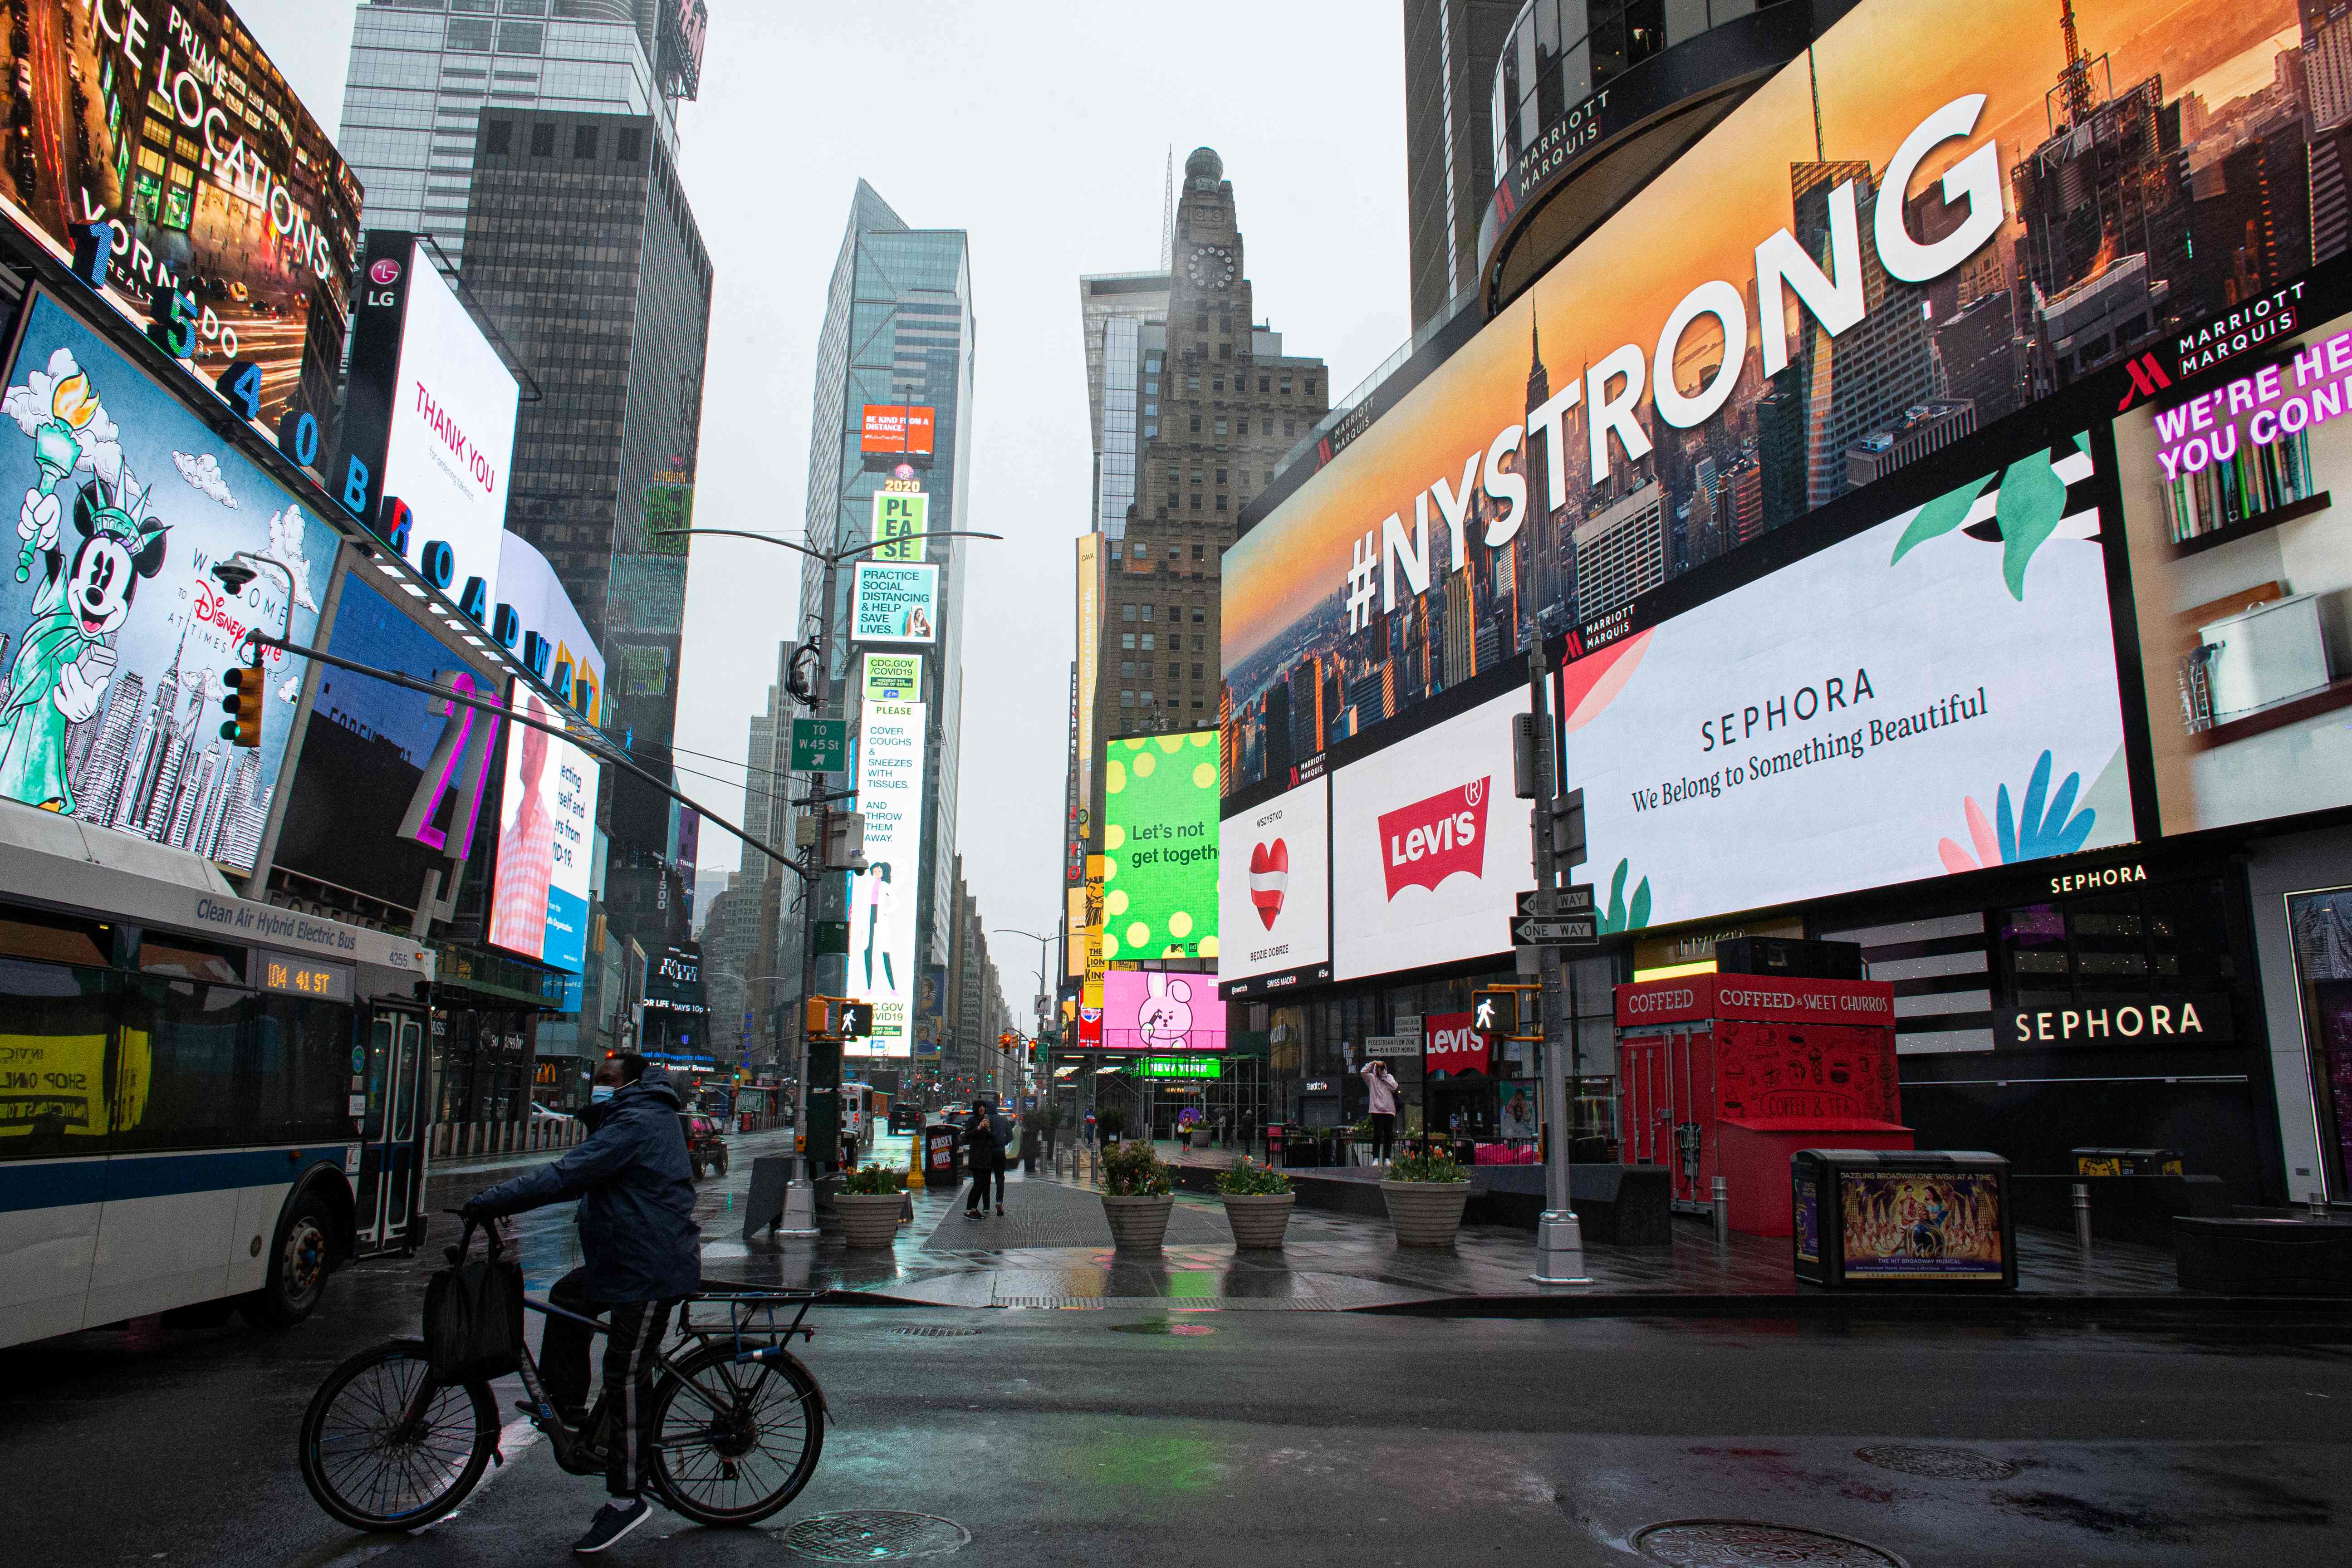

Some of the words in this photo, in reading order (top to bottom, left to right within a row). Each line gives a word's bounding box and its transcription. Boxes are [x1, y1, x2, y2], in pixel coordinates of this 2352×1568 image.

[169, 5, 229, 100] PRIME
[1520, 90, 1609, 175] MARRIOTT
[157, 44, 330, 279] LOCATIONS
[1521, 122, 1597, 197] MARQUIS
[368, 291, 395, 306] LG
[2180, 281, 2305, 354] MARRIOTT
[2182, 313, 2293, 375] MARQUIS
[1347, 93, 2004, 636] #NYSTRONG
[2155, 364, 2281, 444] WE'RE
[1335, 397, 1374, 439] MARRIOTT
[1335, 416, 1369, 453] MARQUIS
[2158, 423, 2237, 481] YOU
[2250, 374, 2352, 445] CON
[416, 381, 466, 463] THANK
[469, 442, 494, 493] YOU
[885, 480, 920, 493] 2020
[1082, 552, 1094, 562] CAVA
[863, 570, 920, 581] PRACTICE
[178, 587, 187, 600] TO
[192, 548, 288, 627] WEOME
[343, 454, 596, 718] BROADWAY
[862, 581, 904, 591] SOCIAL
[862, 592, 930, 603] DISTANCING
[862, 603, 869, 612] &
[872, 603, 902, 612] HELP
[860, 613, 889, 623] SAVE
[1586, 604, 1634, 635] MARRIOTT
[167, 612, 182, 628] AT
[191, 623, 227, 654] TIMES
[860, 624, 894, 634] LIVES.
[1587, 621, 1630, 649] MARQUIS
[870, 667, 913, 676] /COVID19
[871, 659, 913, 667] CDC.GOV
[877, 707, 911, 715] PLEASE
[1701, 668, 1874, 752] SEPHORA
[813, 725, 827, 735] TO
[870, 727, 904, 735] COVER
[799, 739, 809, 749] W
[810, 740, 825, 750] 45
[828, 740, 839, 750] St
[870, 737, 912, 746] COUGHS
[1632, 789, 1658, 813] We
[1662, 771, 1720, 807] Belong
[1725, 764, 1745, 789] to
[1749, 728, 1863, 781] Something
[1868, 686, 1988, 746] Beautiful
[868, 758, 912, 768] SNEEZES
[1301, 753, 1326, 770] MARRIOTT
[1301, 765, 1323, 782] MARQUIS
[867, 779, 909, 789] TISSUES.
[573, 802, 585, 819] and
[866, 801, 887, 809] AND
[866, 812, 902, 821] THROW
[1256, 810, 1282, 828] WSZYSTKO
[565, 819, 580, 844] from
[865, 823, 893, 831] THEM
[1177, 821, 1204, 838] not
[864, 833, 893, 842] AWAY.
[1132, 848, 1158, 868] get
[1163, 844, 1220, 866] togeth
[2051, 865, 2147, 894] SEPHORA
[1560, 895, 1583, 906] WAY
[197, 899, 232, 925] Clean
[235, 909, 254, 929] Air
[256, 913, 294, 938] Hybrid
[297, 922, 334, 946] Electric
[337, 929, 356, 951] Bus
[1524, 926, 1548, 936] ONE
[1560, 925, 1585, 936] WAY
[389, 951, 408, 967] 4255
[1269, 944, 1289, 957] DOBRZE
[1087, 956, 1104, 968] LION
[296, 968, 309, 990] 41
[313, 972, 330, 994] ST
[1231, 984, 1247, 995] @swatch
[1267, 979, 1280, 988] SWISS
[1280, 976, 1293, 986] MADE
[1629, 989, 1694, 1014] COFFEED
[1720, 989, 1795, 1009] COFFEED
[1796, 997, 1803, 1005] &
[1804, 994, 1836, 1010] SWEET
[1840, 995, 1887, 1013] CHURROS
[2015, 1003, 2203, 1041] SEPHORA
[1307, 1082, 1324, 1091] swatch
[1769, 1096, 1806, 1116] COFFEE
[1814, 1096, 1823, 1117] &
[1829, 1098, 1850, 1116] TEA
[931, 1135, 952, 1149] JERSEY
[933, 1152, 951, 1165] BOYS
